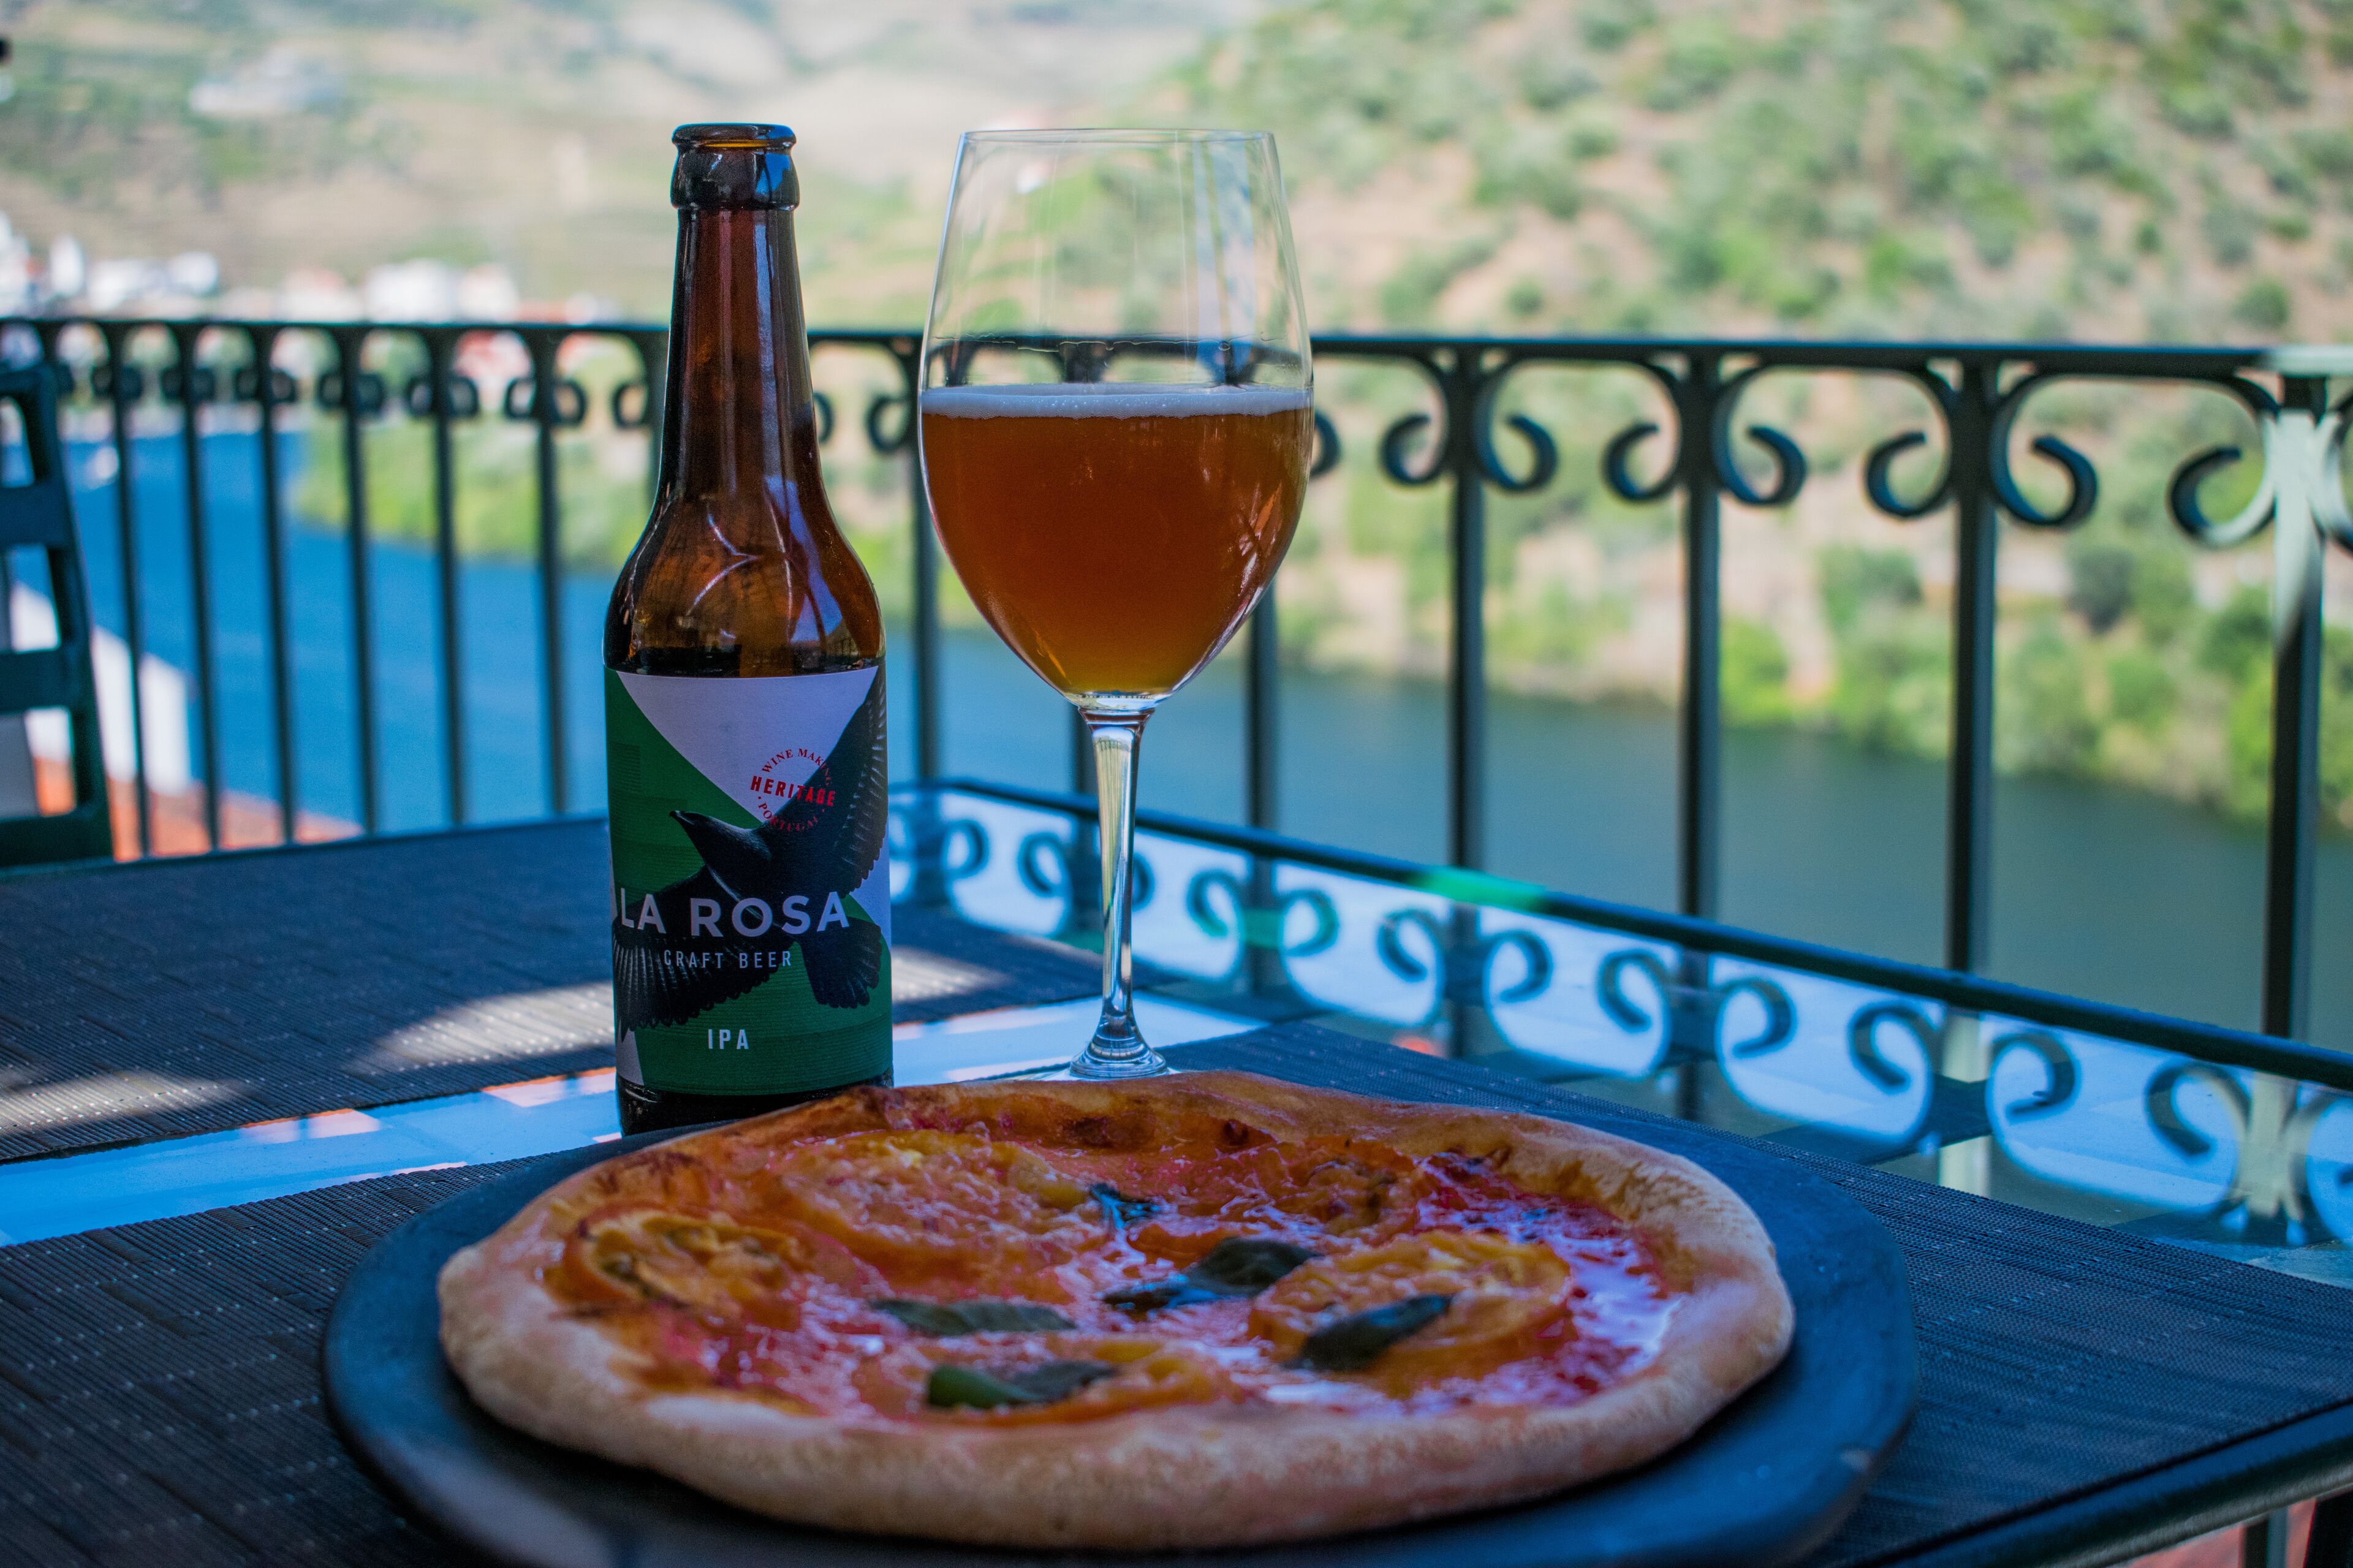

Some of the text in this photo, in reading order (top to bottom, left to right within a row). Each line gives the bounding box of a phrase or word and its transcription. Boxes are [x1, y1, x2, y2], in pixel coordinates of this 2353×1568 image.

[762, 749, 794, 773] WINE
[751, 776, 836, 806] HERITAGE
[621, 887, 850, 937] LA ROSA
[664, 949, 792, 969] CRAFT BEER
[708, 1029, 749, 1050] IPA
